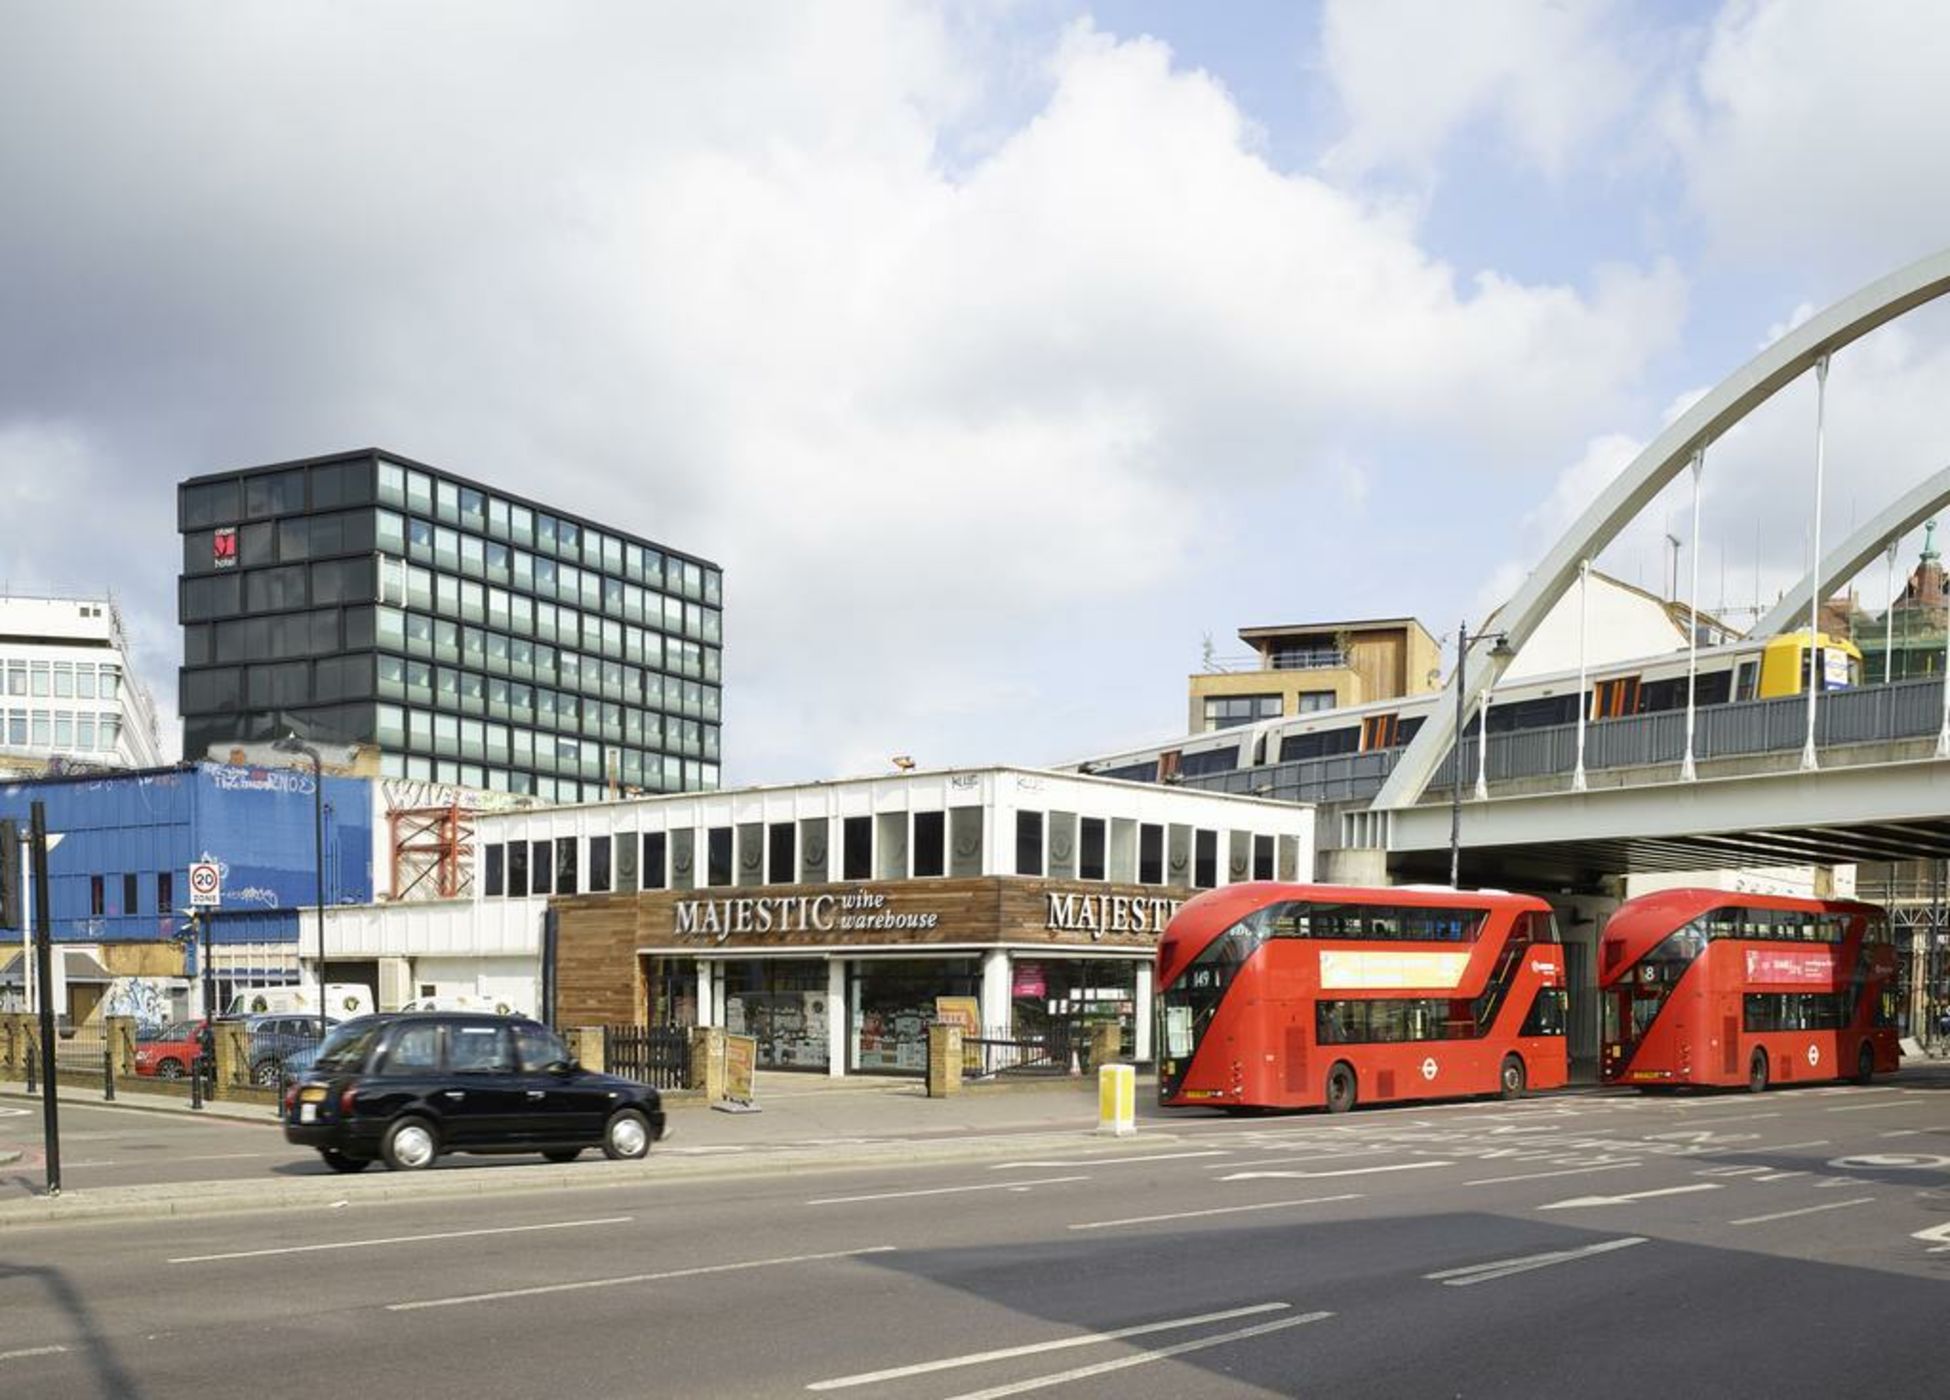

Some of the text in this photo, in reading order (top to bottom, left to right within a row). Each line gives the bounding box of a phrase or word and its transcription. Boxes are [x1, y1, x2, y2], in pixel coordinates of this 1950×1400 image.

[196, 873, 214, 886] 20
[193, 894, 217, 903] ZONE
[674, 889, 885, 941] MAJESTIC wine
[840, 910, 938, 930] warehouse
[1644, 966, 1654, 981] 8
